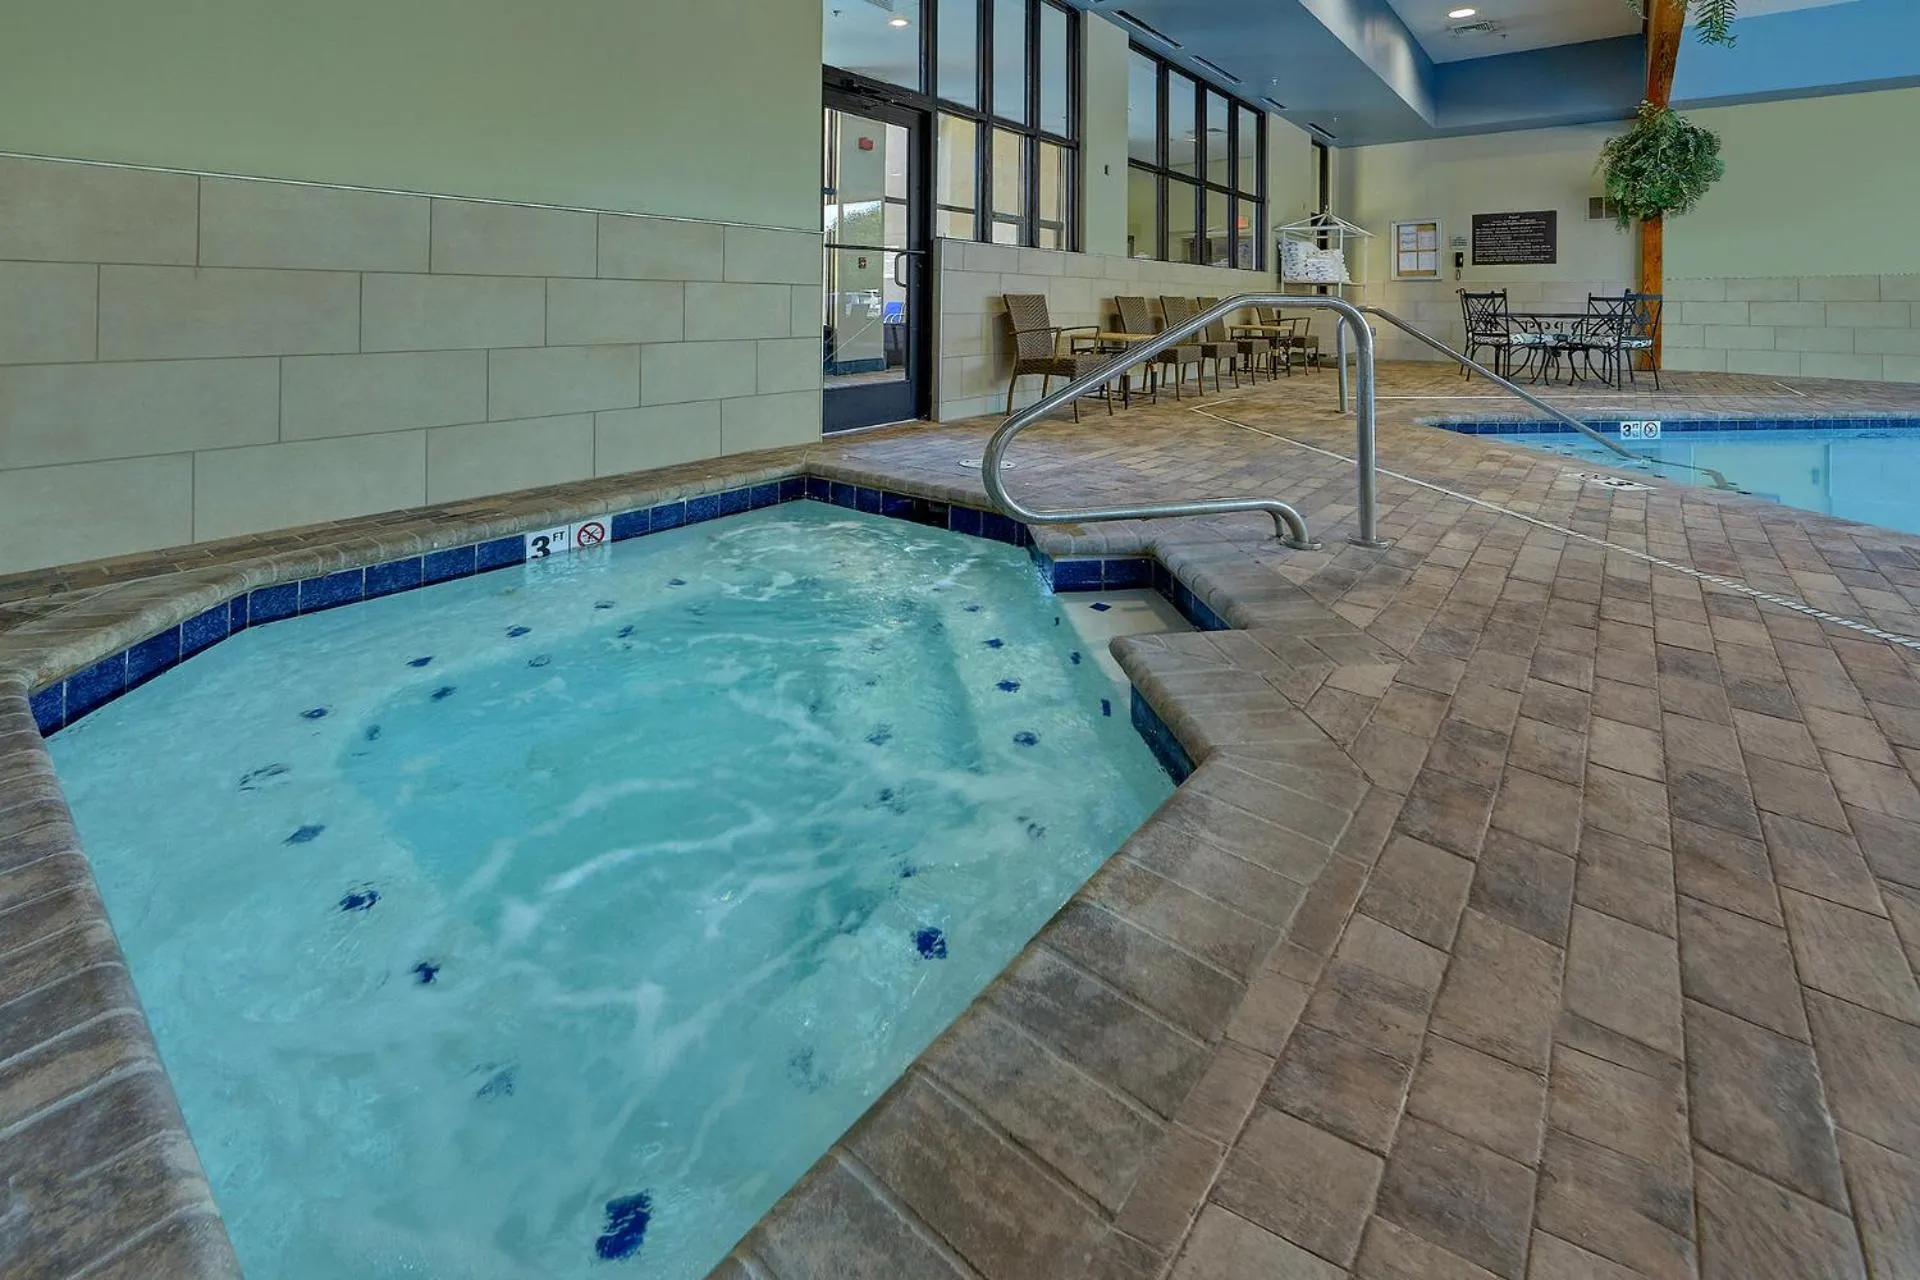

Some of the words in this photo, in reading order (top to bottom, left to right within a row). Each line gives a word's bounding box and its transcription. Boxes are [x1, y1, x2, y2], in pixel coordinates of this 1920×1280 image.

[1623, 424, 1631, 437] 3
[531, 535, 550, 558] 3
[553, 531, 565, 542] FT
